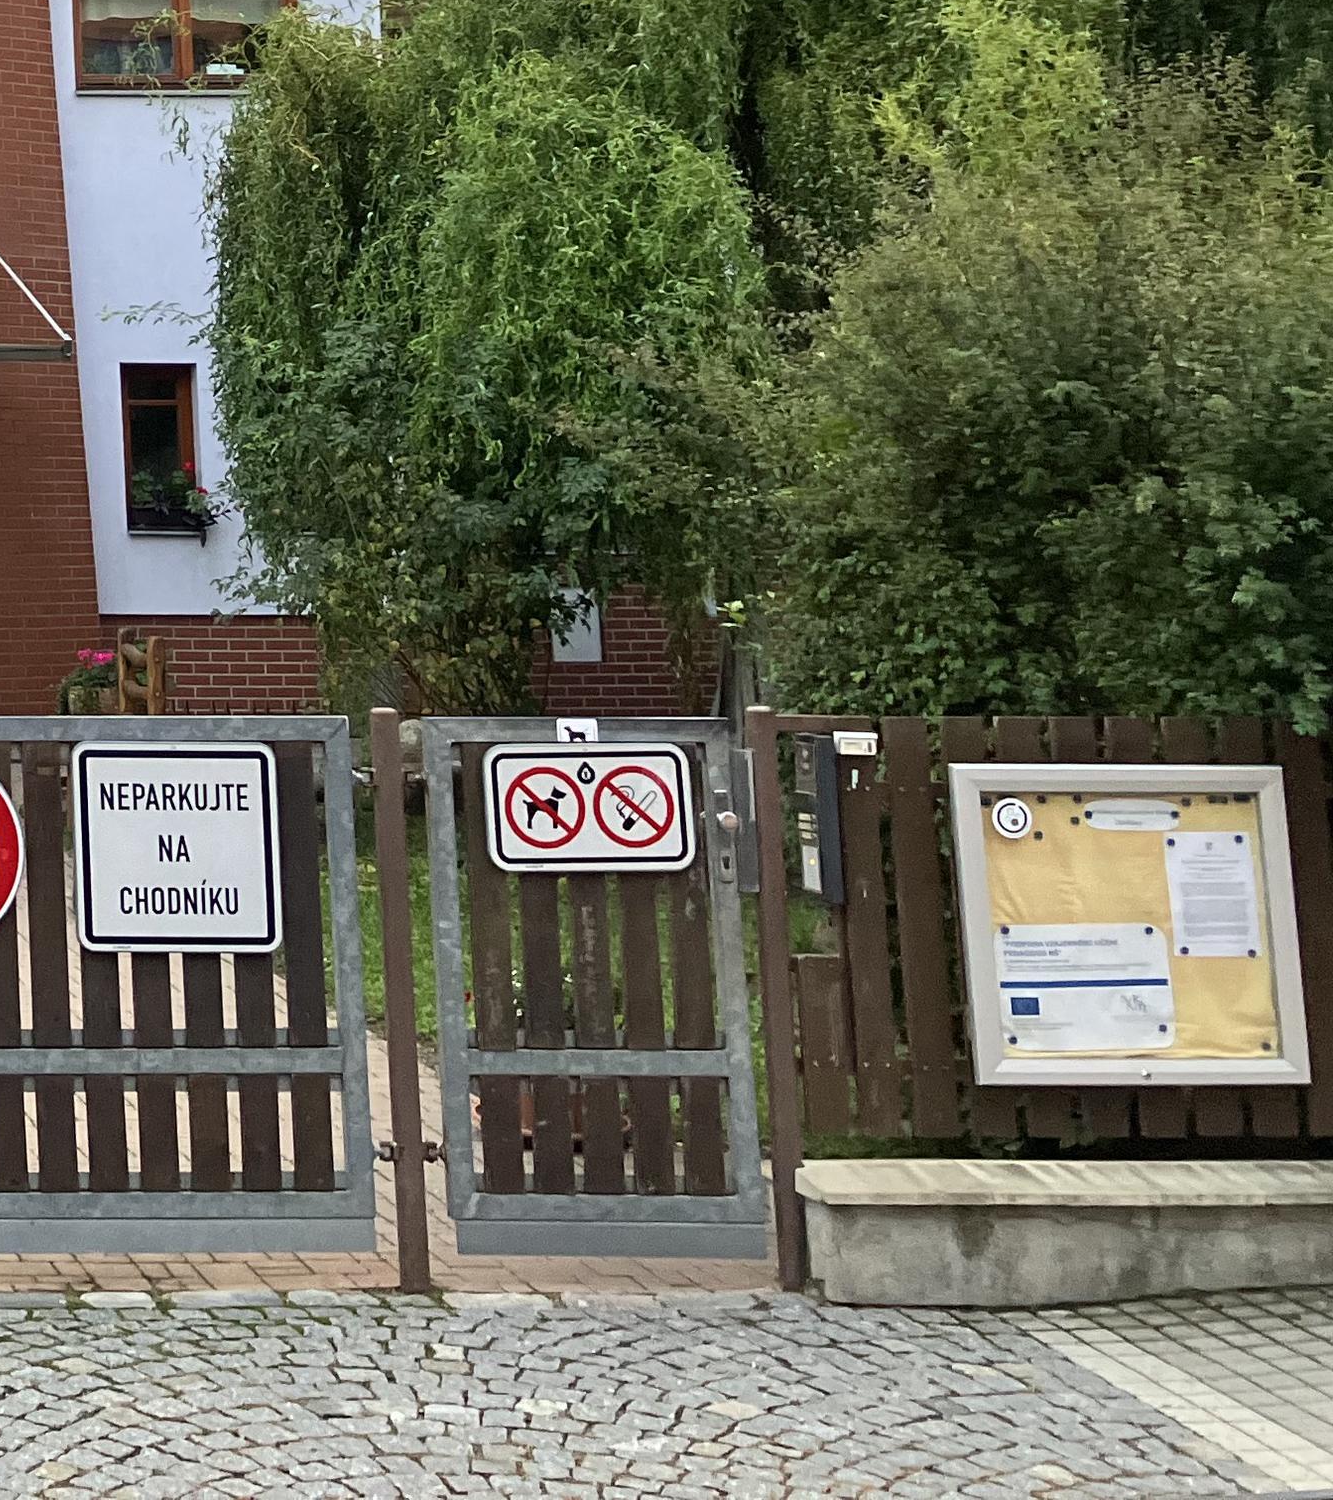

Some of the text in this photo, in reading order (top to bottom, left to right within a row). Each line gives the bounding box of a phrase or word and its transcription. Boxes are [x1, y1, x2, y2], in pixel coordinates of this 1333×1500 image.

[99, 782, 250, 811] NEPARKUJTE
[158, 834, 191, 863] NA
[119, 878, 239, 915] CHODNÍKU
